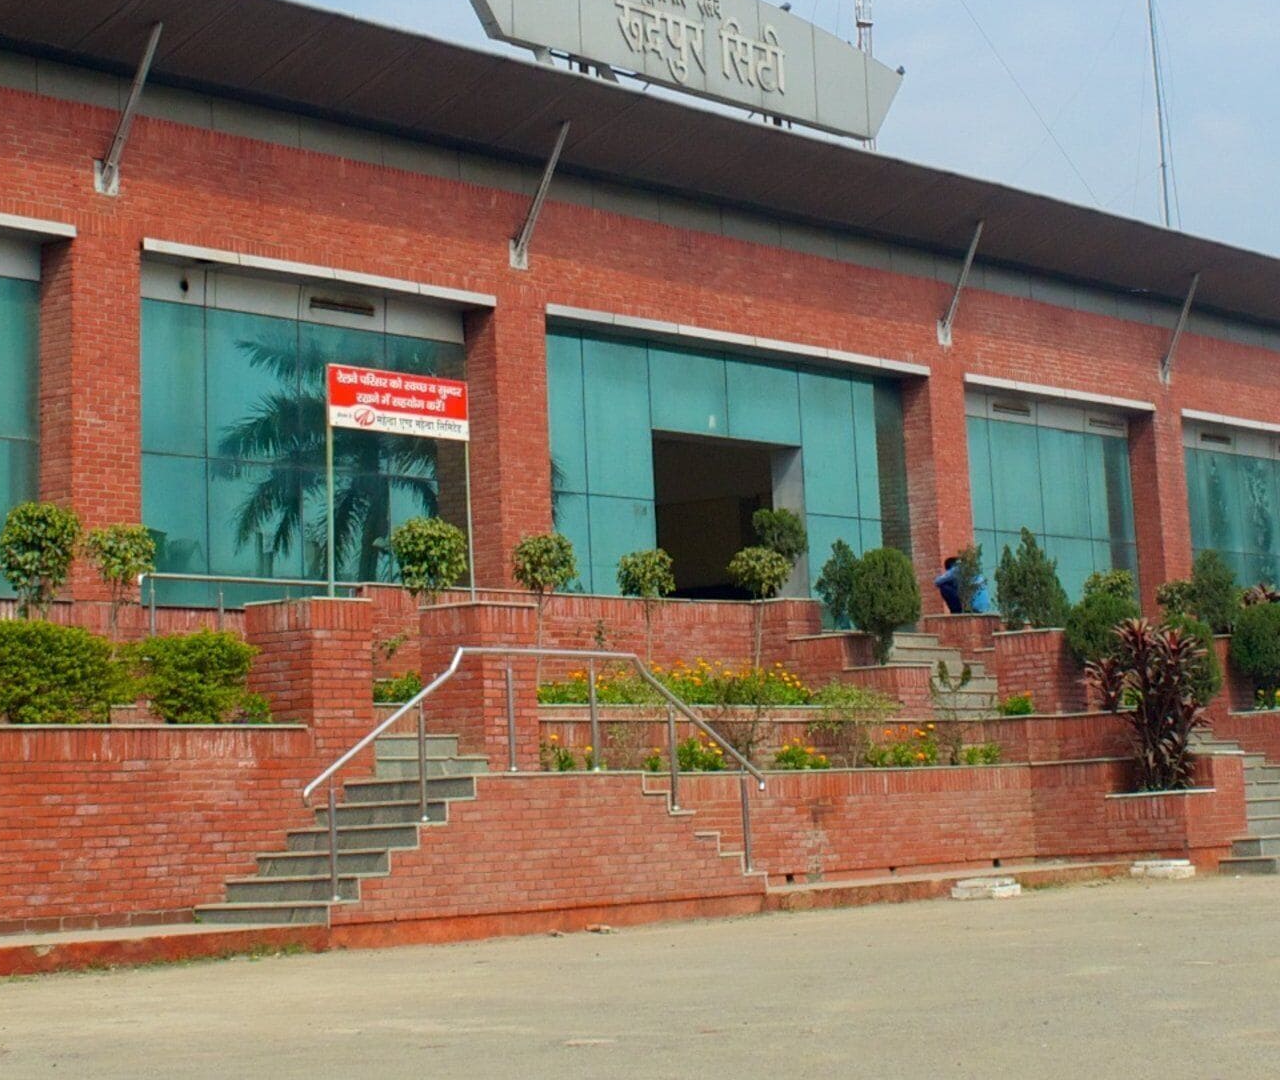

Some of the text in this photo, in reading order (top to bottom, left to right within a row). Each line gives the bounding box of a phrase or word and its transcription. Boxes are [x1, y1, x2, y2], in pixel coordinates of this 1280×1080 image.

[719, 16, 785, 96] सिटी
[336, 369, 358, 384] रेलवे
[360, 372, 388, 388] परिसर
[389, 376, 402, 389] को
[356, 391, 379, 404] रखने
[381, 392, 391, 405] में
[392, 395, 424, 409] सहयोग
